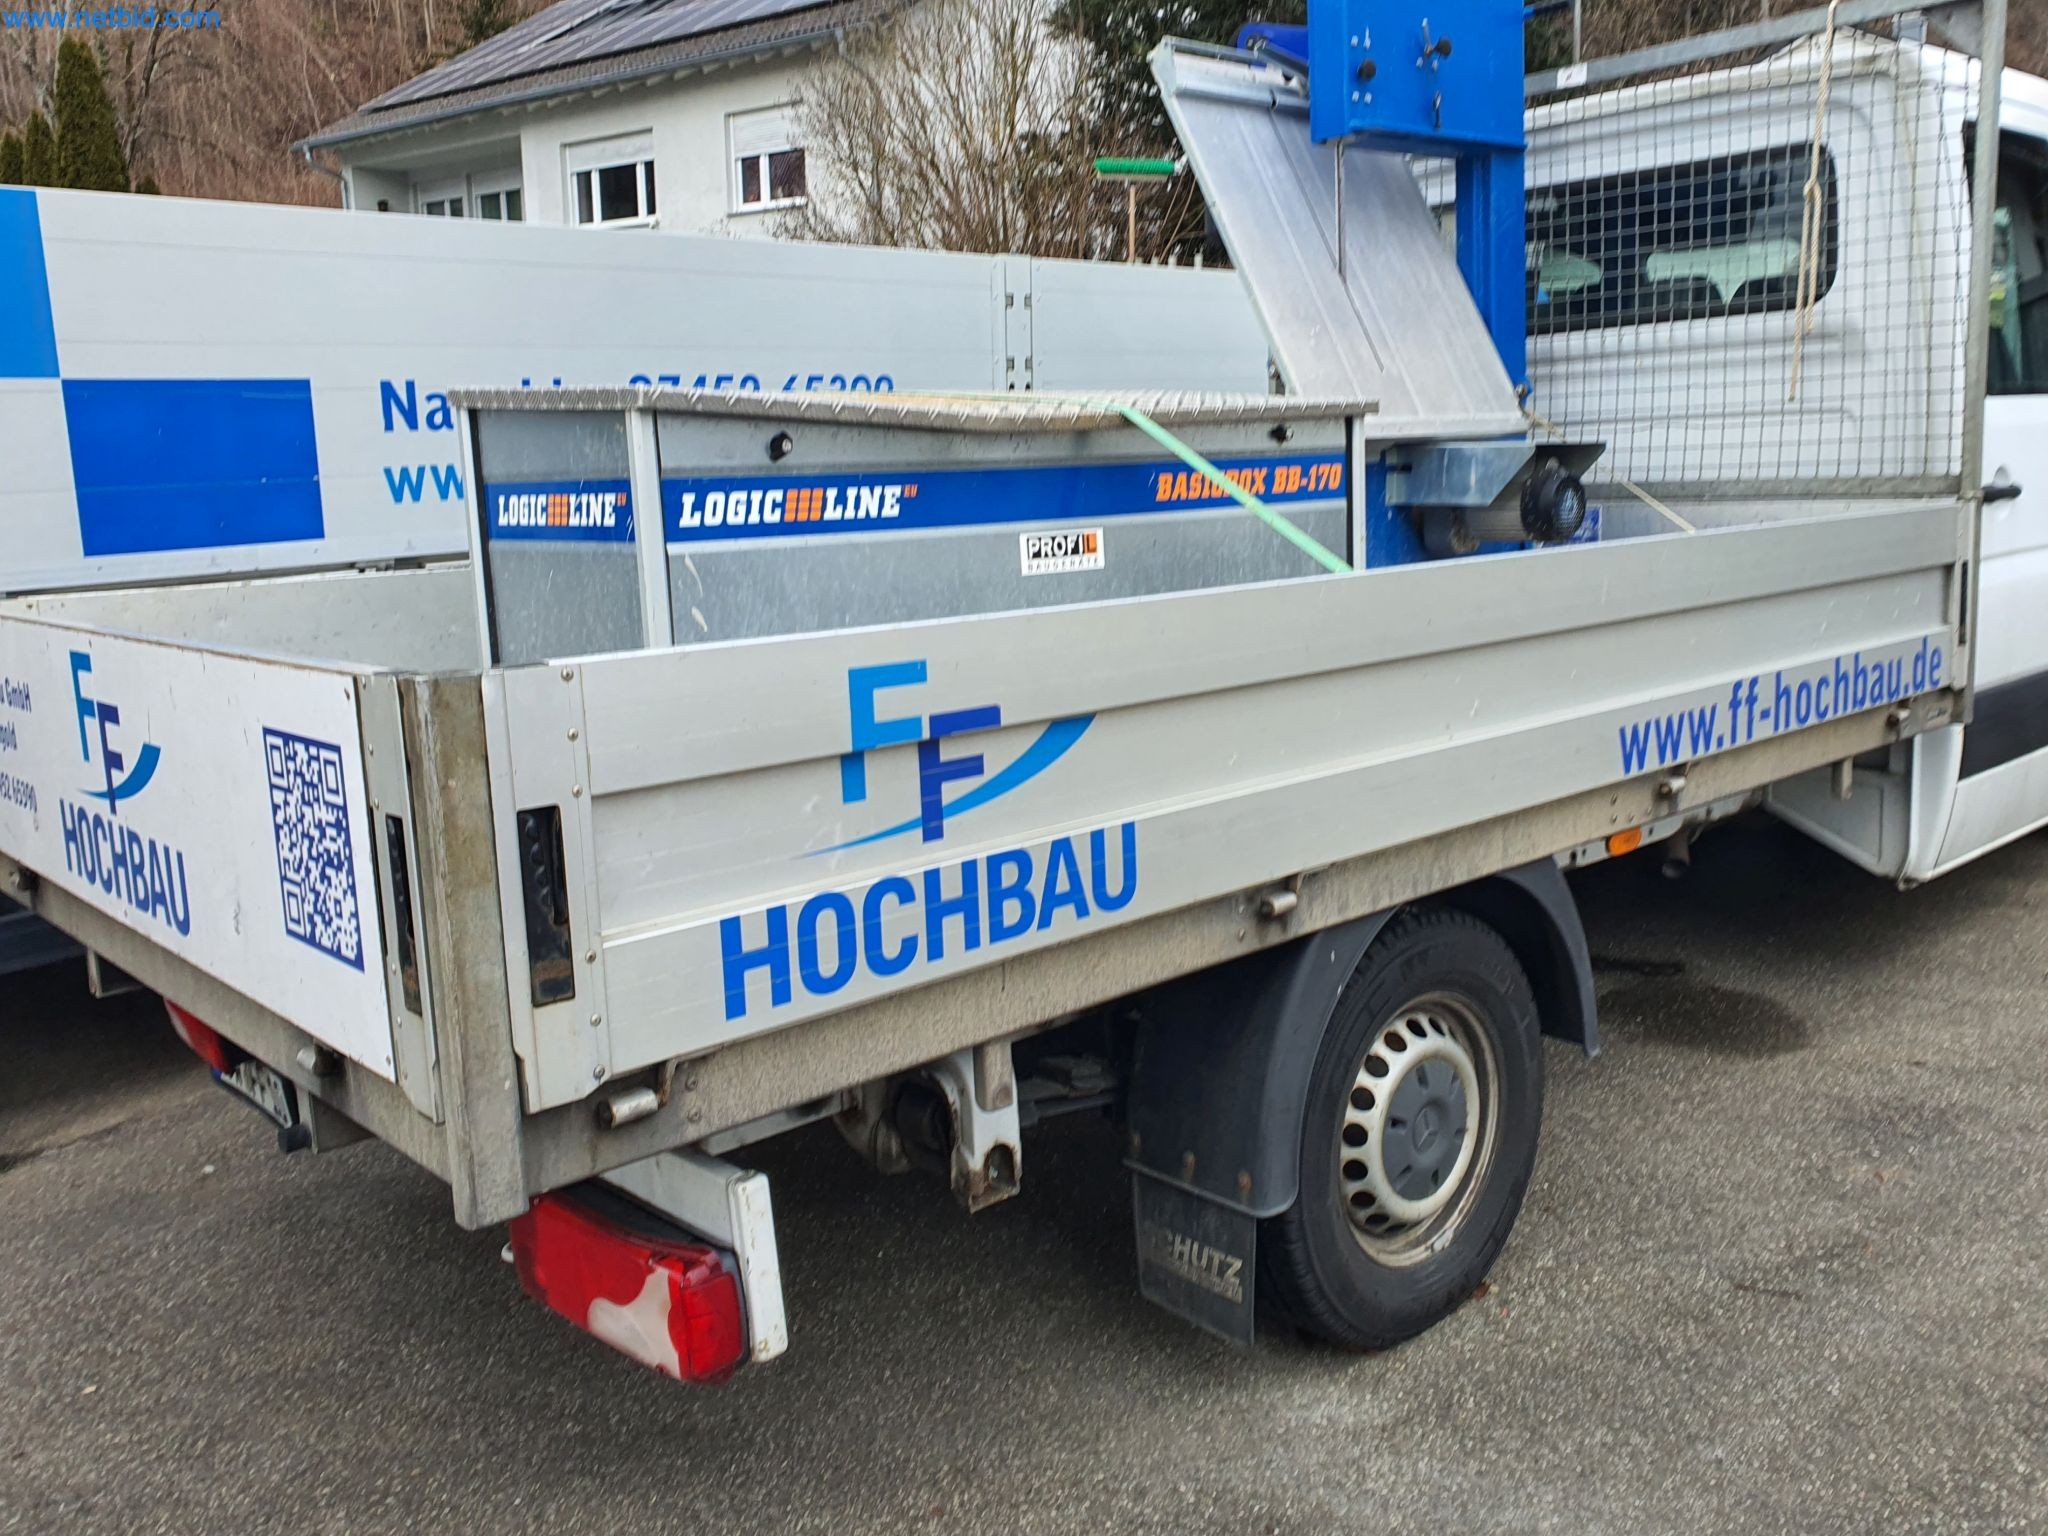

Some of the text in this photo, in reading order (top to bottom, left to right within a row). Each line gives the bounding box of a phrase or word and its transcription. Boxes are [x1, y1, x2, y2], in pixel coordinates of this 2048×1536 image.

[1027, 531, 1098, 560] PROFIL
[1272, 462, 1343, 495] BB-170
[1618, 635, 1943, 776] www.ff-hochbau.de
[58, 797, 191, 937] HOCHBAU
[719, 820, 1137, 1022] HOCHBAU
